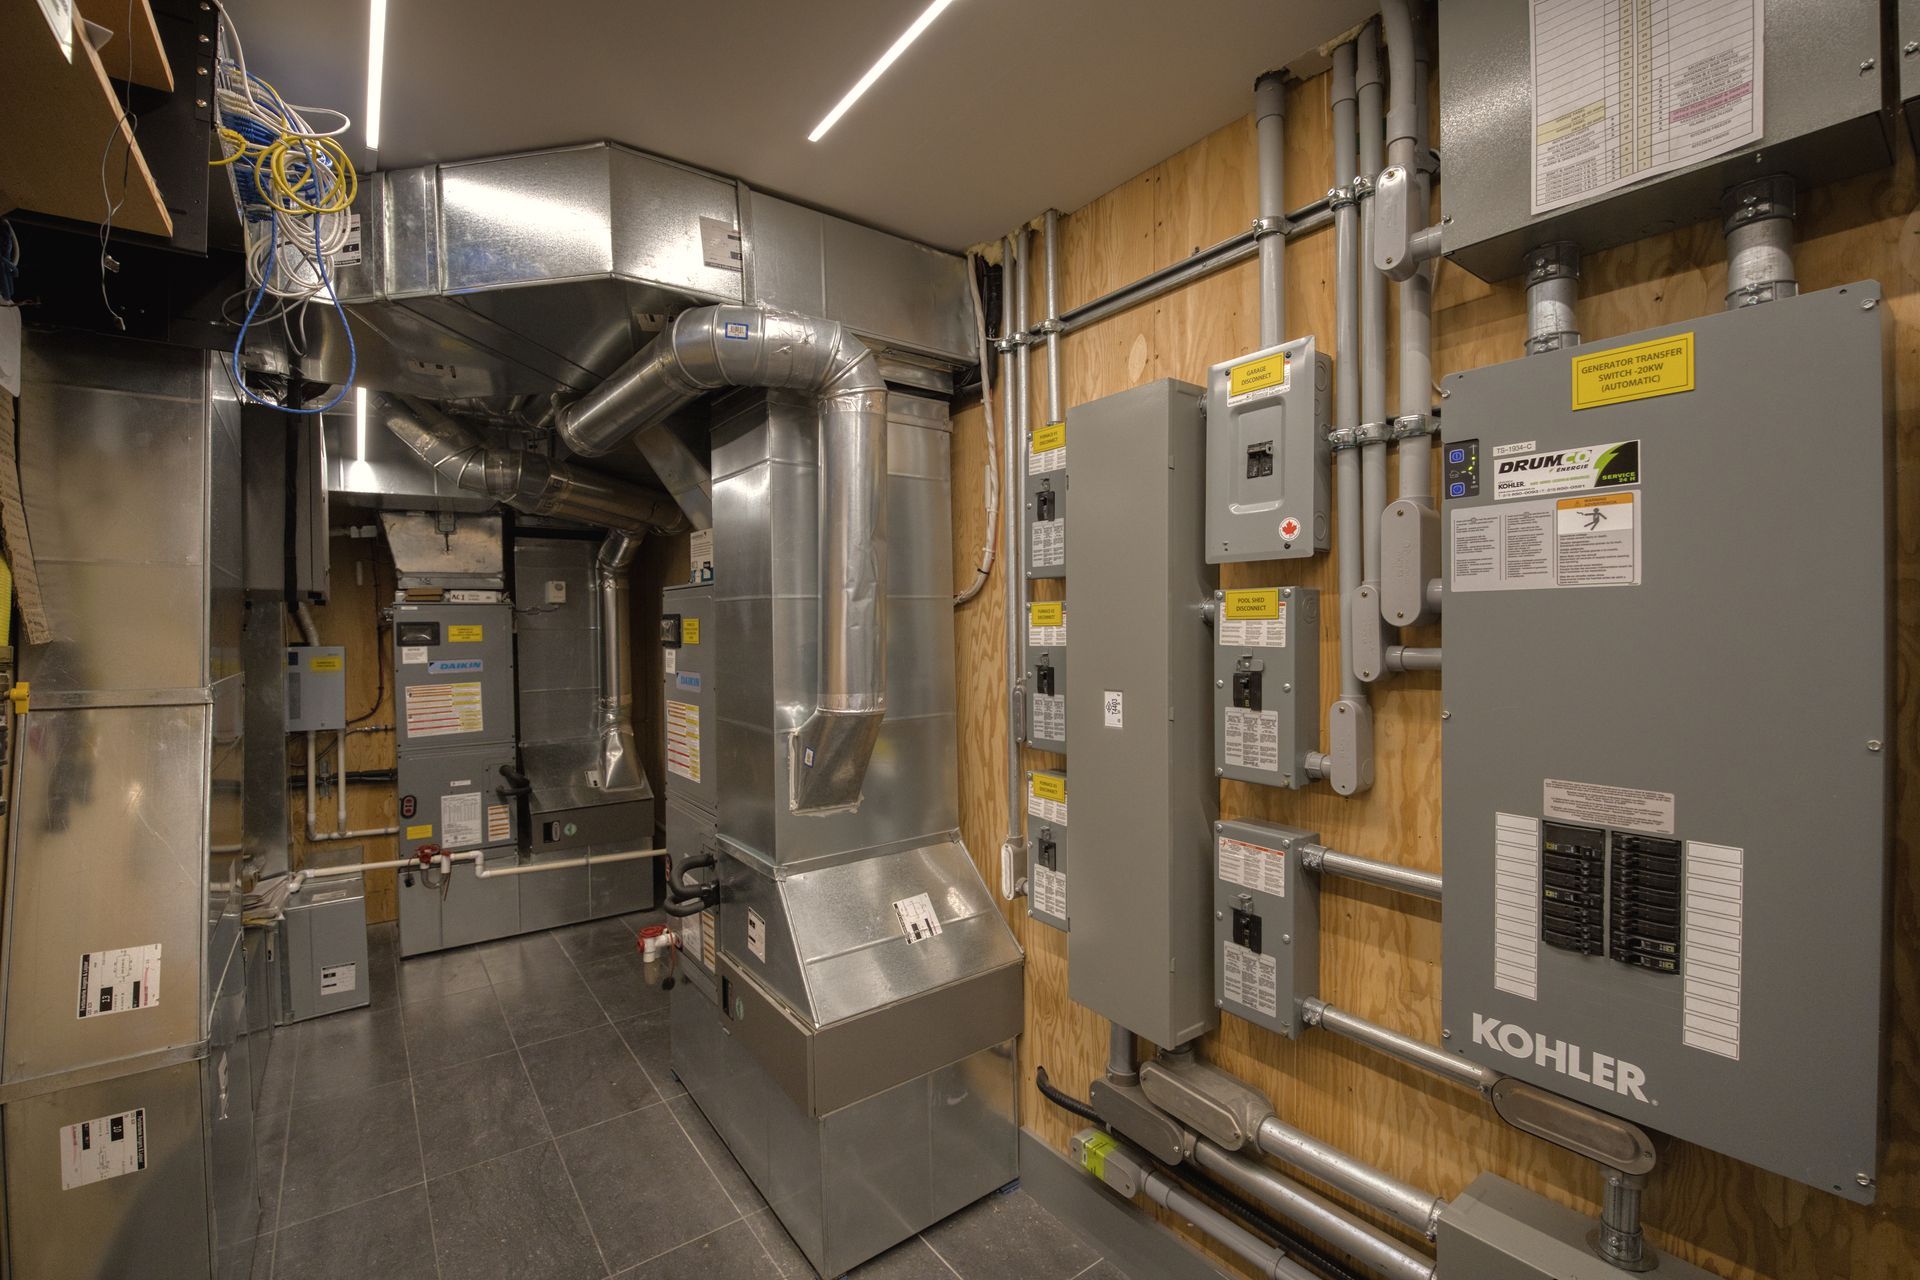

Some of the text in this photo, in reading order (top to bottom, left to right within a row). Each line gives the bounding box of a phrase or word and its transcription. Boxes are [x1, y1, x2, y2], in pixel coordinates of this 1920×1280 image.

[1581, 347, 1682, 374] GENERATOR TRANSFER
[1246, 366, 1266, 376] GARAGE
[1598, 368, 1632, 382] SWITCH
[1241, 373, 1271, 385] DISCONNECT
[1601, 374, 1661, 393] (AUTOMATIC)
[1496, 444, 1532, 454] TS-1934-C
[1498, 450, 1592, 474] DRUMCO
[1602, 472, 1636, 480] SERVICE
[1498, 481, 1524, 490] KOHLER
[1473, 1012, 1650, 1103] KOHLER
